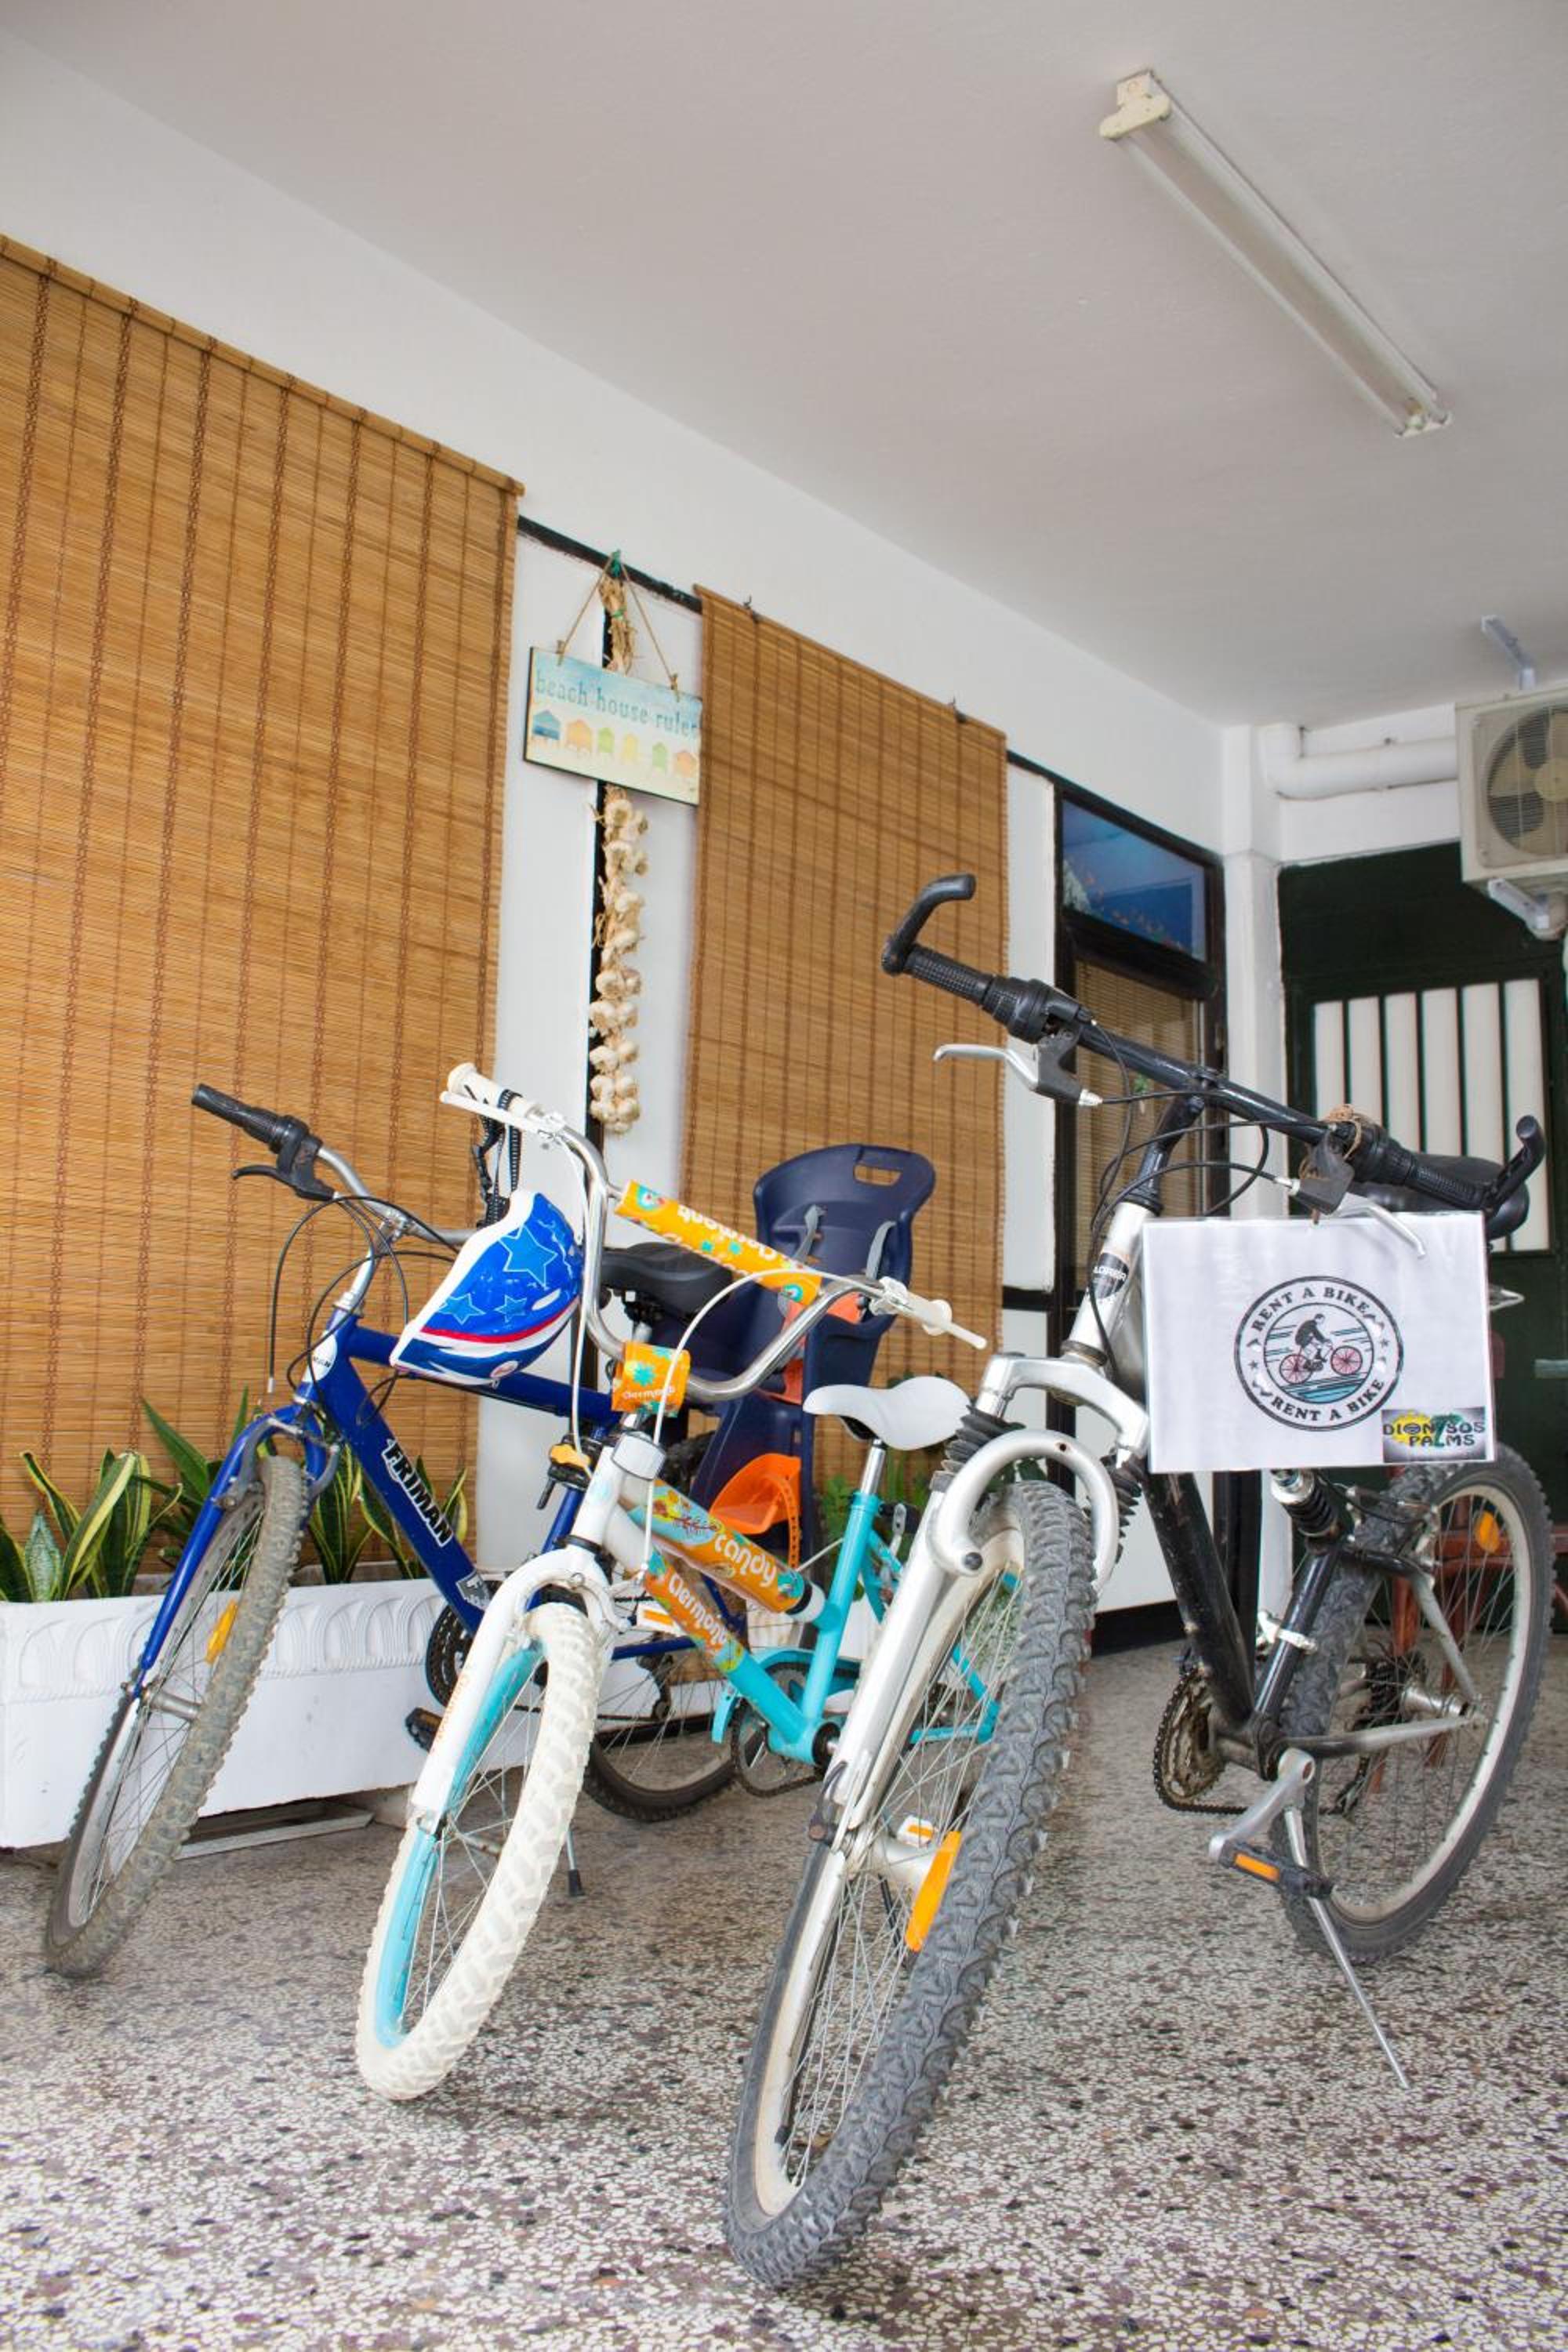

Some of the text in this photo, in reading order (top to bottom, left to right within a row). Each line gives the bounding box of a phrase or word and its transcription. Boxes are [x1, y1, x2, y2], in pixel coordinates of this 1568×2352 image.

[535, 670, 588, 706] beach
[596, 687, 649, 724] house
[1251, 1287, 1370, 1332] RENT A BIKE
[1271, 1379, 1385, 1421] RENT A BIKE
[1409, 1435, 1475, 1447] PALMS
